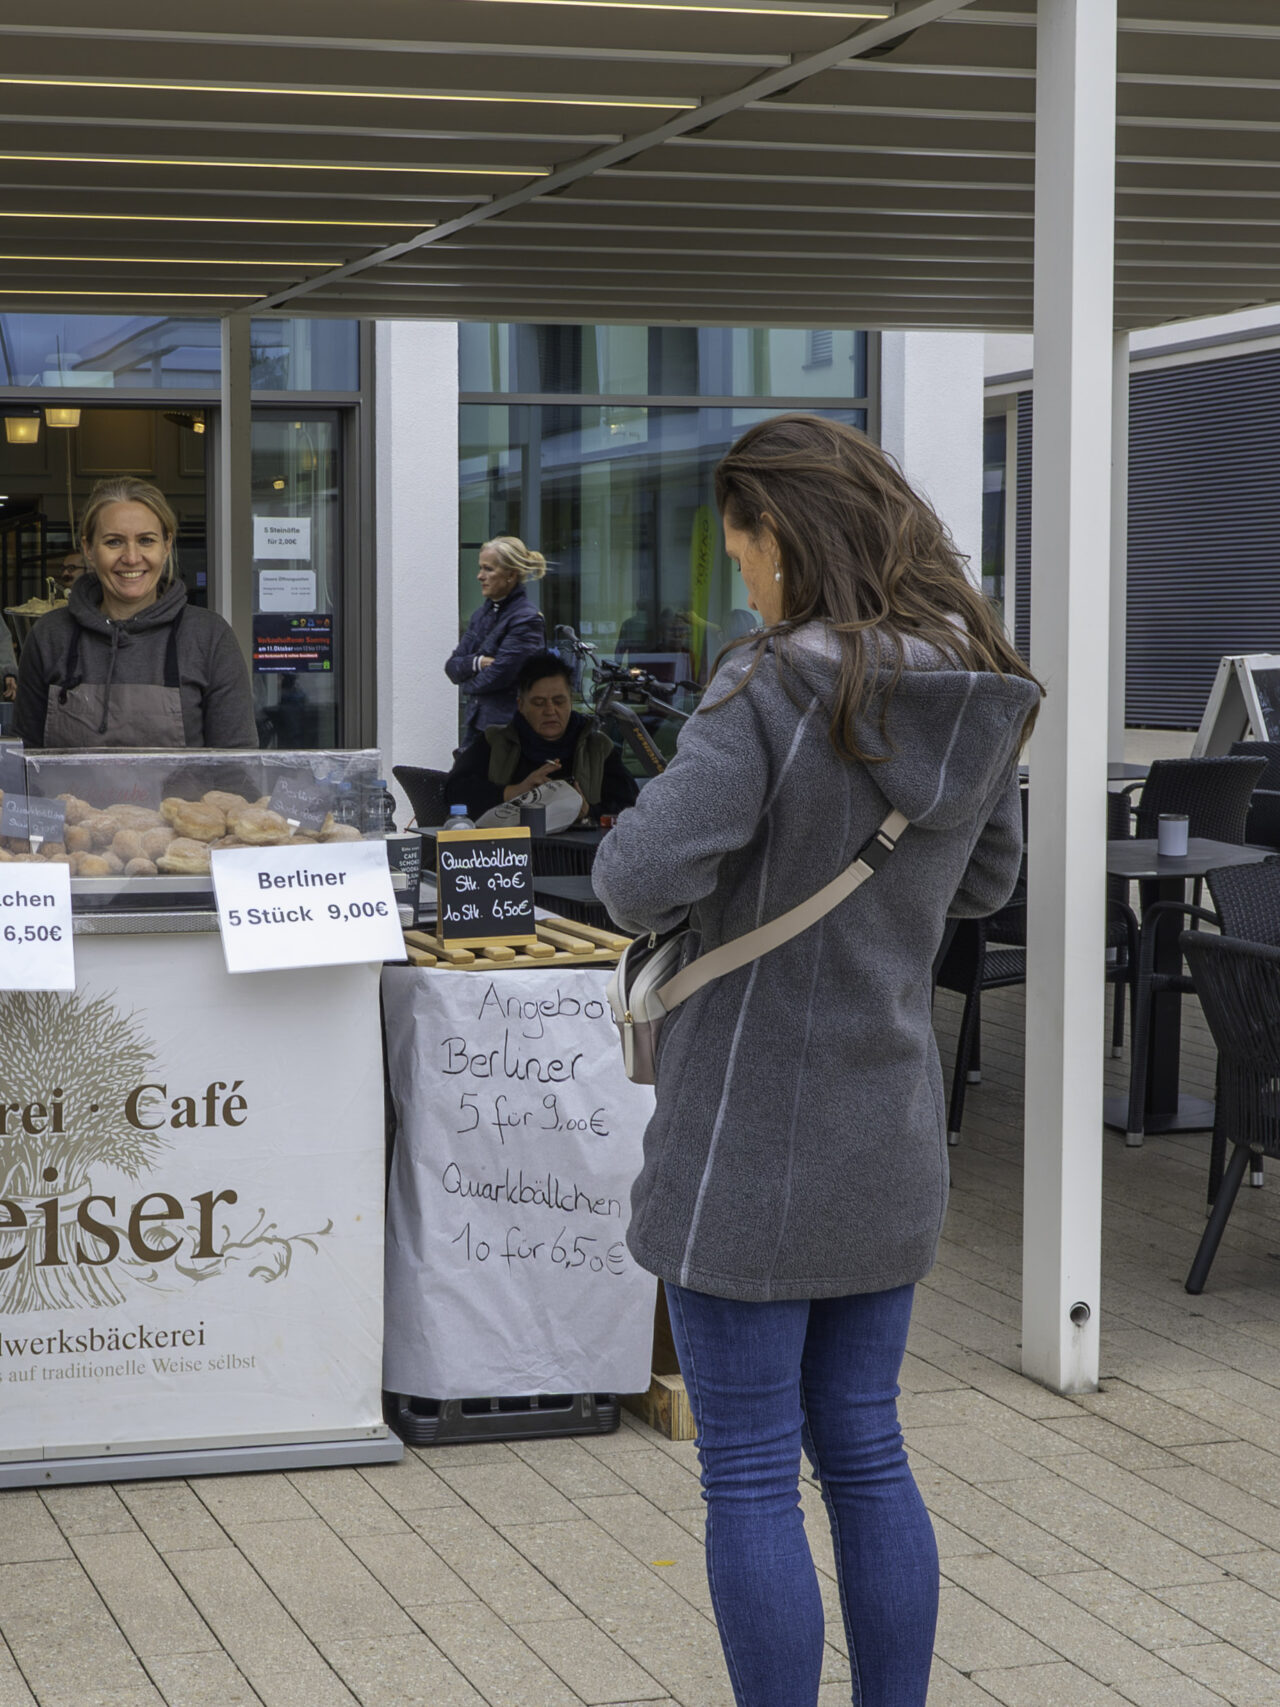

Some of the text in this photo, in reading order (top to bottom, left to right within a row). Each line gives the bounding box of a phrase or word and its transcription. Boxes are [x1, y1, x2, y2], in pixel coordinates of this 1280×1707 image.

[441, 847, 528, 871] Quarkbällchen
[258, 869, 347, 889] Berliner
[455, 871, 525, 892] Stk. 0,70€
[228, 901, 389, 926] 5 Stück 9,00€
[443, 899, 532, 921] 10 Stk. 6,50€
[4, 925, 62, 944] 6,50€
[478, 982, 614, 1039] Angebo
[441, 1028, 583, 1082] Berliner
[125, 1080, 248, 1131] Café
[456, 1093, 609, 1145] 5 für 9,00€
[442, 1162, 621, 1218] Quarkbällchen
[452, 1222, 626, 1276] 10 für 6,50€
[8, 1364, 37, 1383] auf
[42, 1358, 147, 1381] traditionelle
[152, 1356, 203, 1376] Weise
[208, 1353, 257, 1371] selbst
